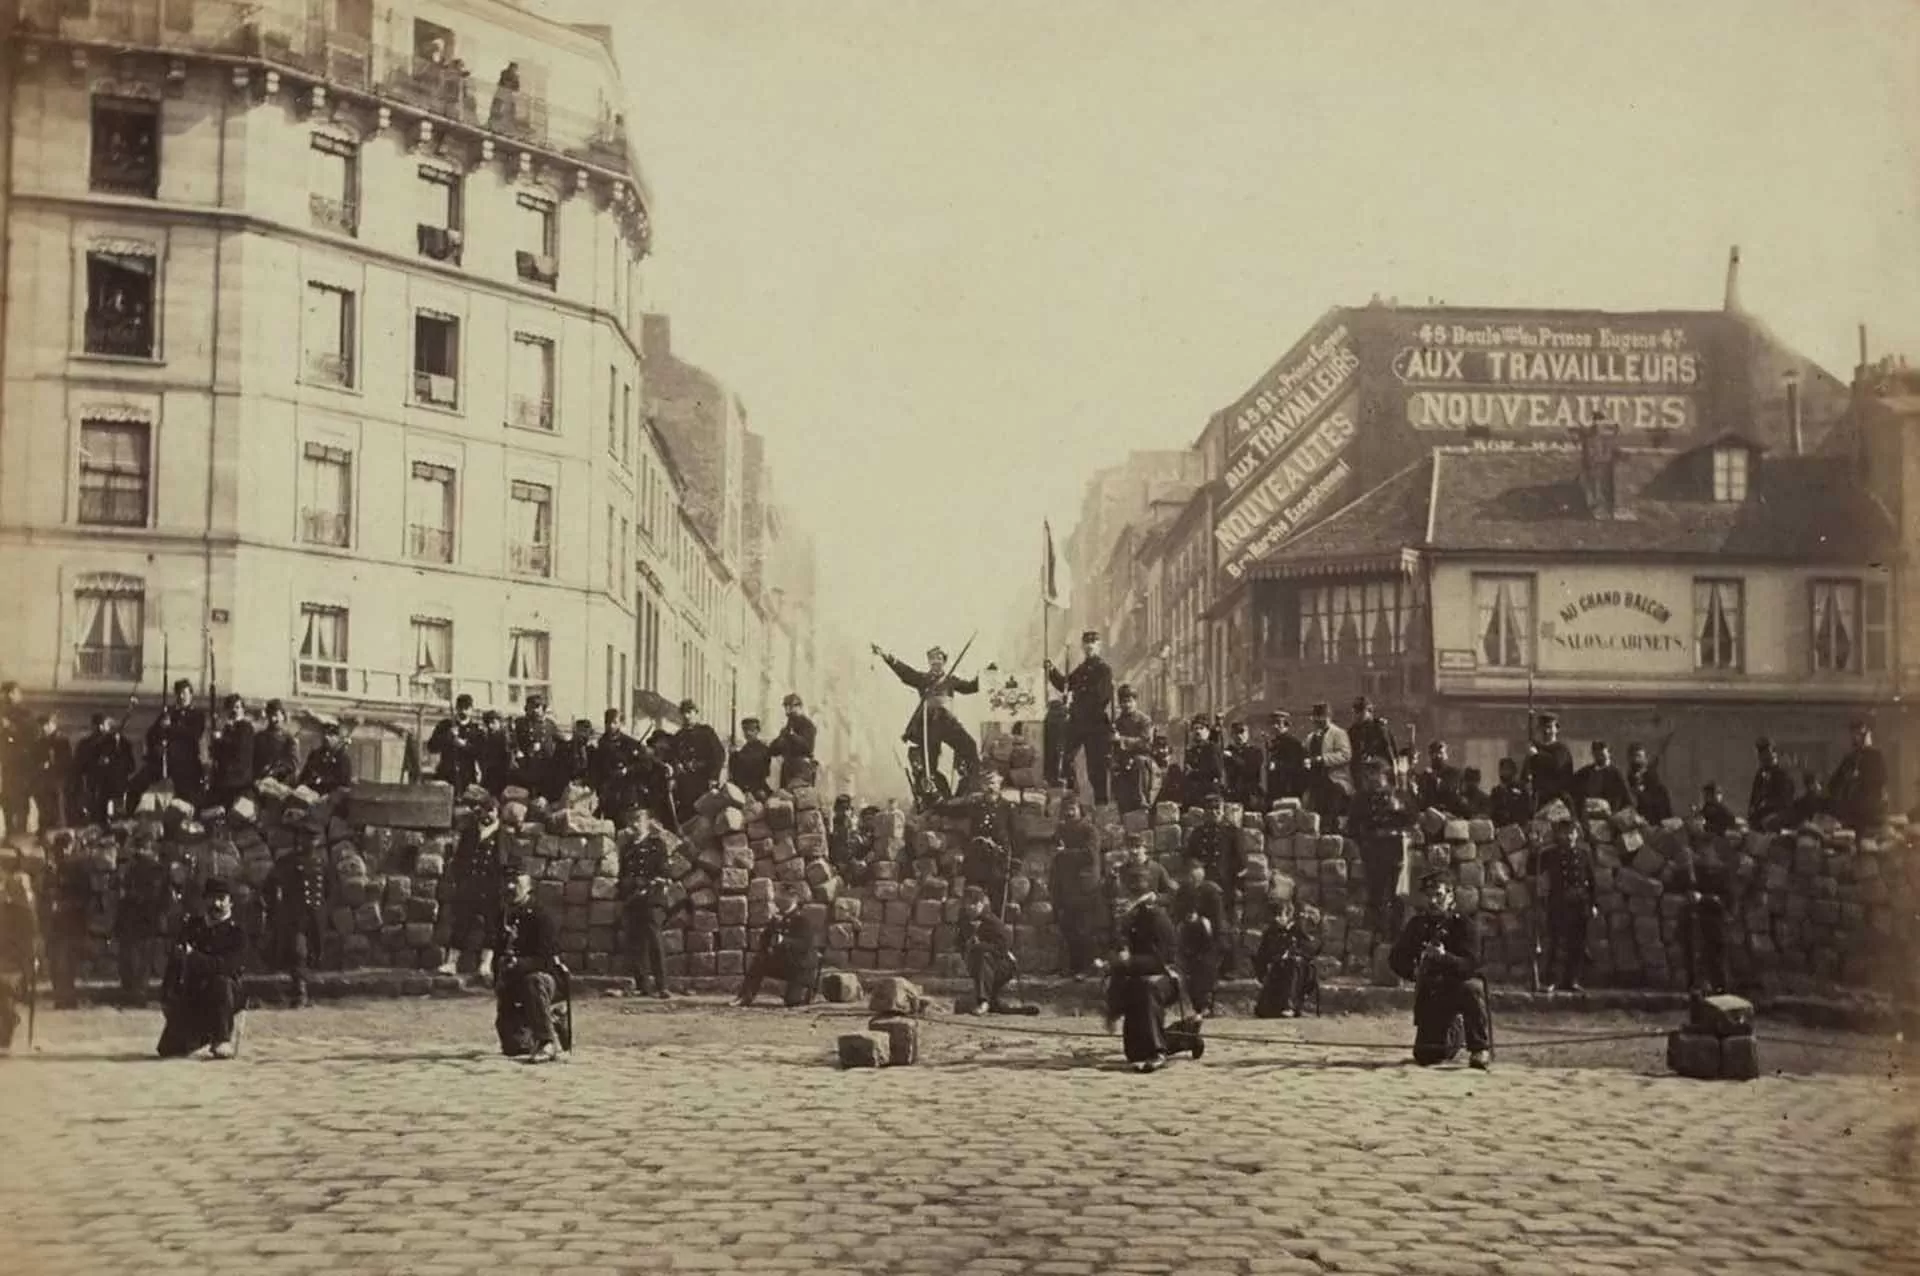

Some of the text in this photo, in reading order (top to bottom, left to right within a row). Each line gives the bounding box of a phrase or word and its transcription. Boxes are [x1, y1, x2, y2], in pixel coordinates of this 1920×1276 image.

[1538, 327, 1593, 347] Prince
[1406, 349, 1698, 383] AUX TRAVAILLEURS
[1224, 346, 1360, 490] AUX TRAVAILLEURS
[1559, 602, 1579, 623] AU
